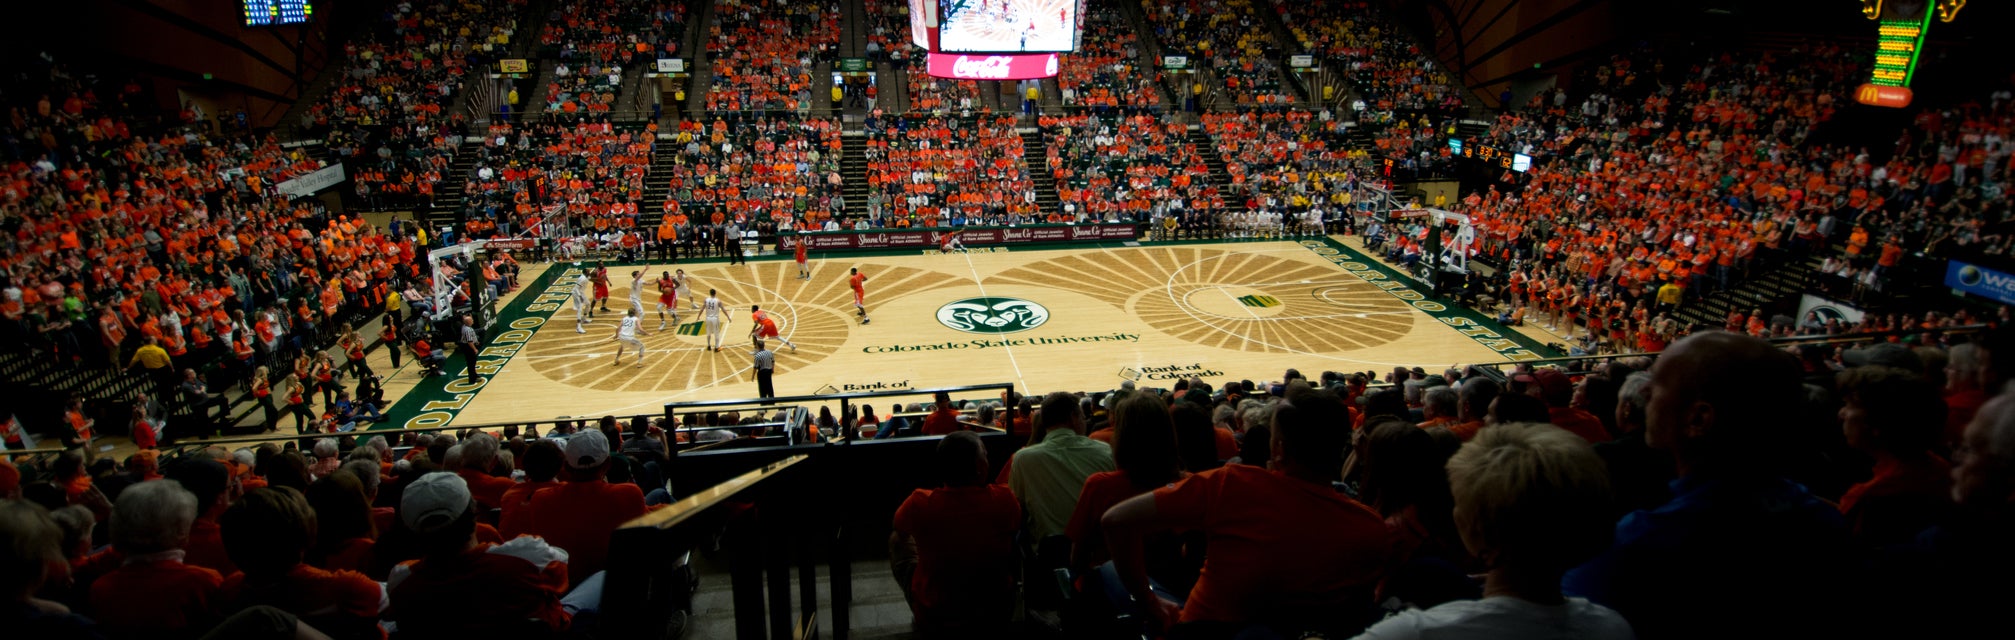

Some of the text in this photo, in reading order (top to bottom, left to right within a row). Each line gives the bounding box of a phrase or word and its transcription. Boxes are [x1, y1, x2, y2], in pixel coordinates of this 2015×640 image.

[1300, 239, 1545, 362] COLORADO STAT
[623, 318, 634, 328] 23
[863, 332, 1141, 353] Colorado State University
[404, 316, 546, 429] OLORADO
[1141, 363, 1202, 374] Bank of
[1148, 369, 1225, 381] Colorado
[844, 382, 887, 391] Bank
[891, 380, 910, 388] of
